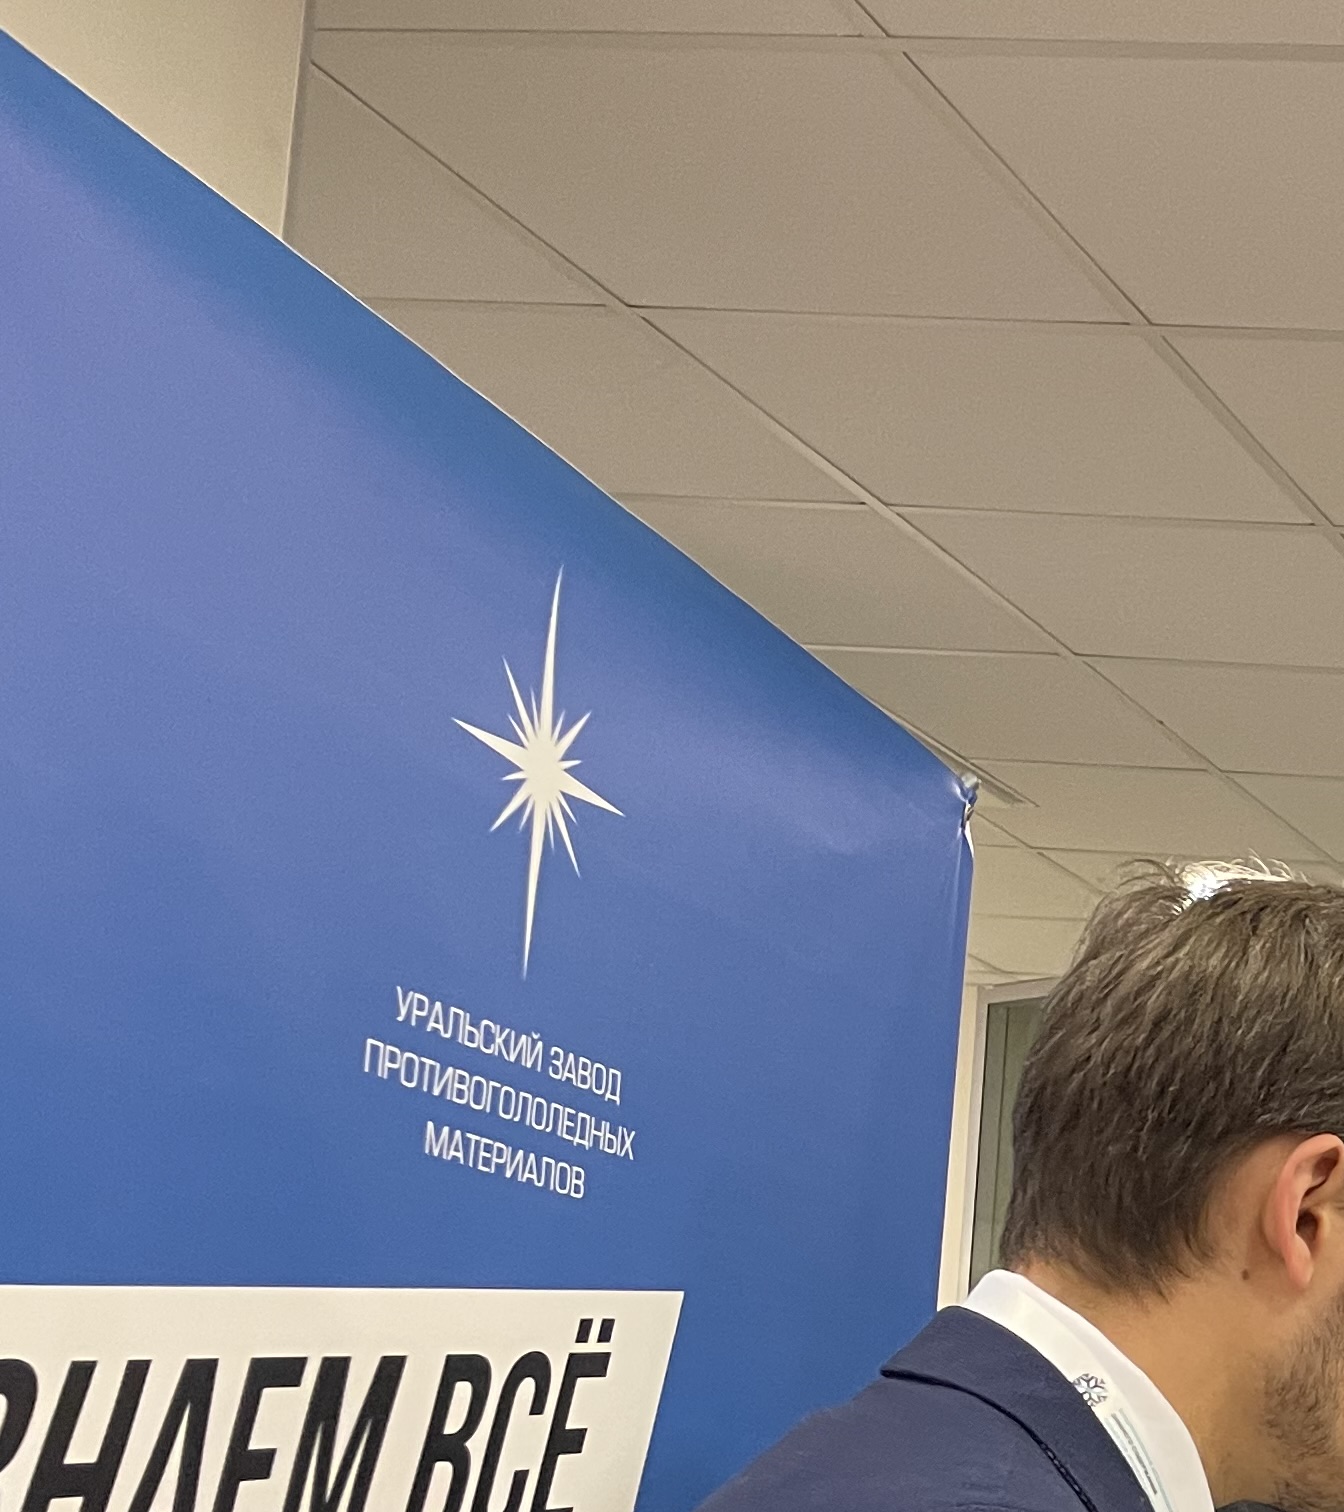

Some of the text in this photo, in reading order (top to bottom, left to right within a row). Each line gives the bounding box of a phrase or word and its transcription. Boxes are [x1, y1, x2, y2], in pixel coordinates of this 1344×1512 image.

[362, 1037, 637, 1161] ПРОТИВОГОЛОЛЕДНЫХ
[395, 985, 623, 1106] УРАЛЬСКИЙ ЗАВОД
[424, 1120, 586, 1200] МАТЕРИАЛОВ
